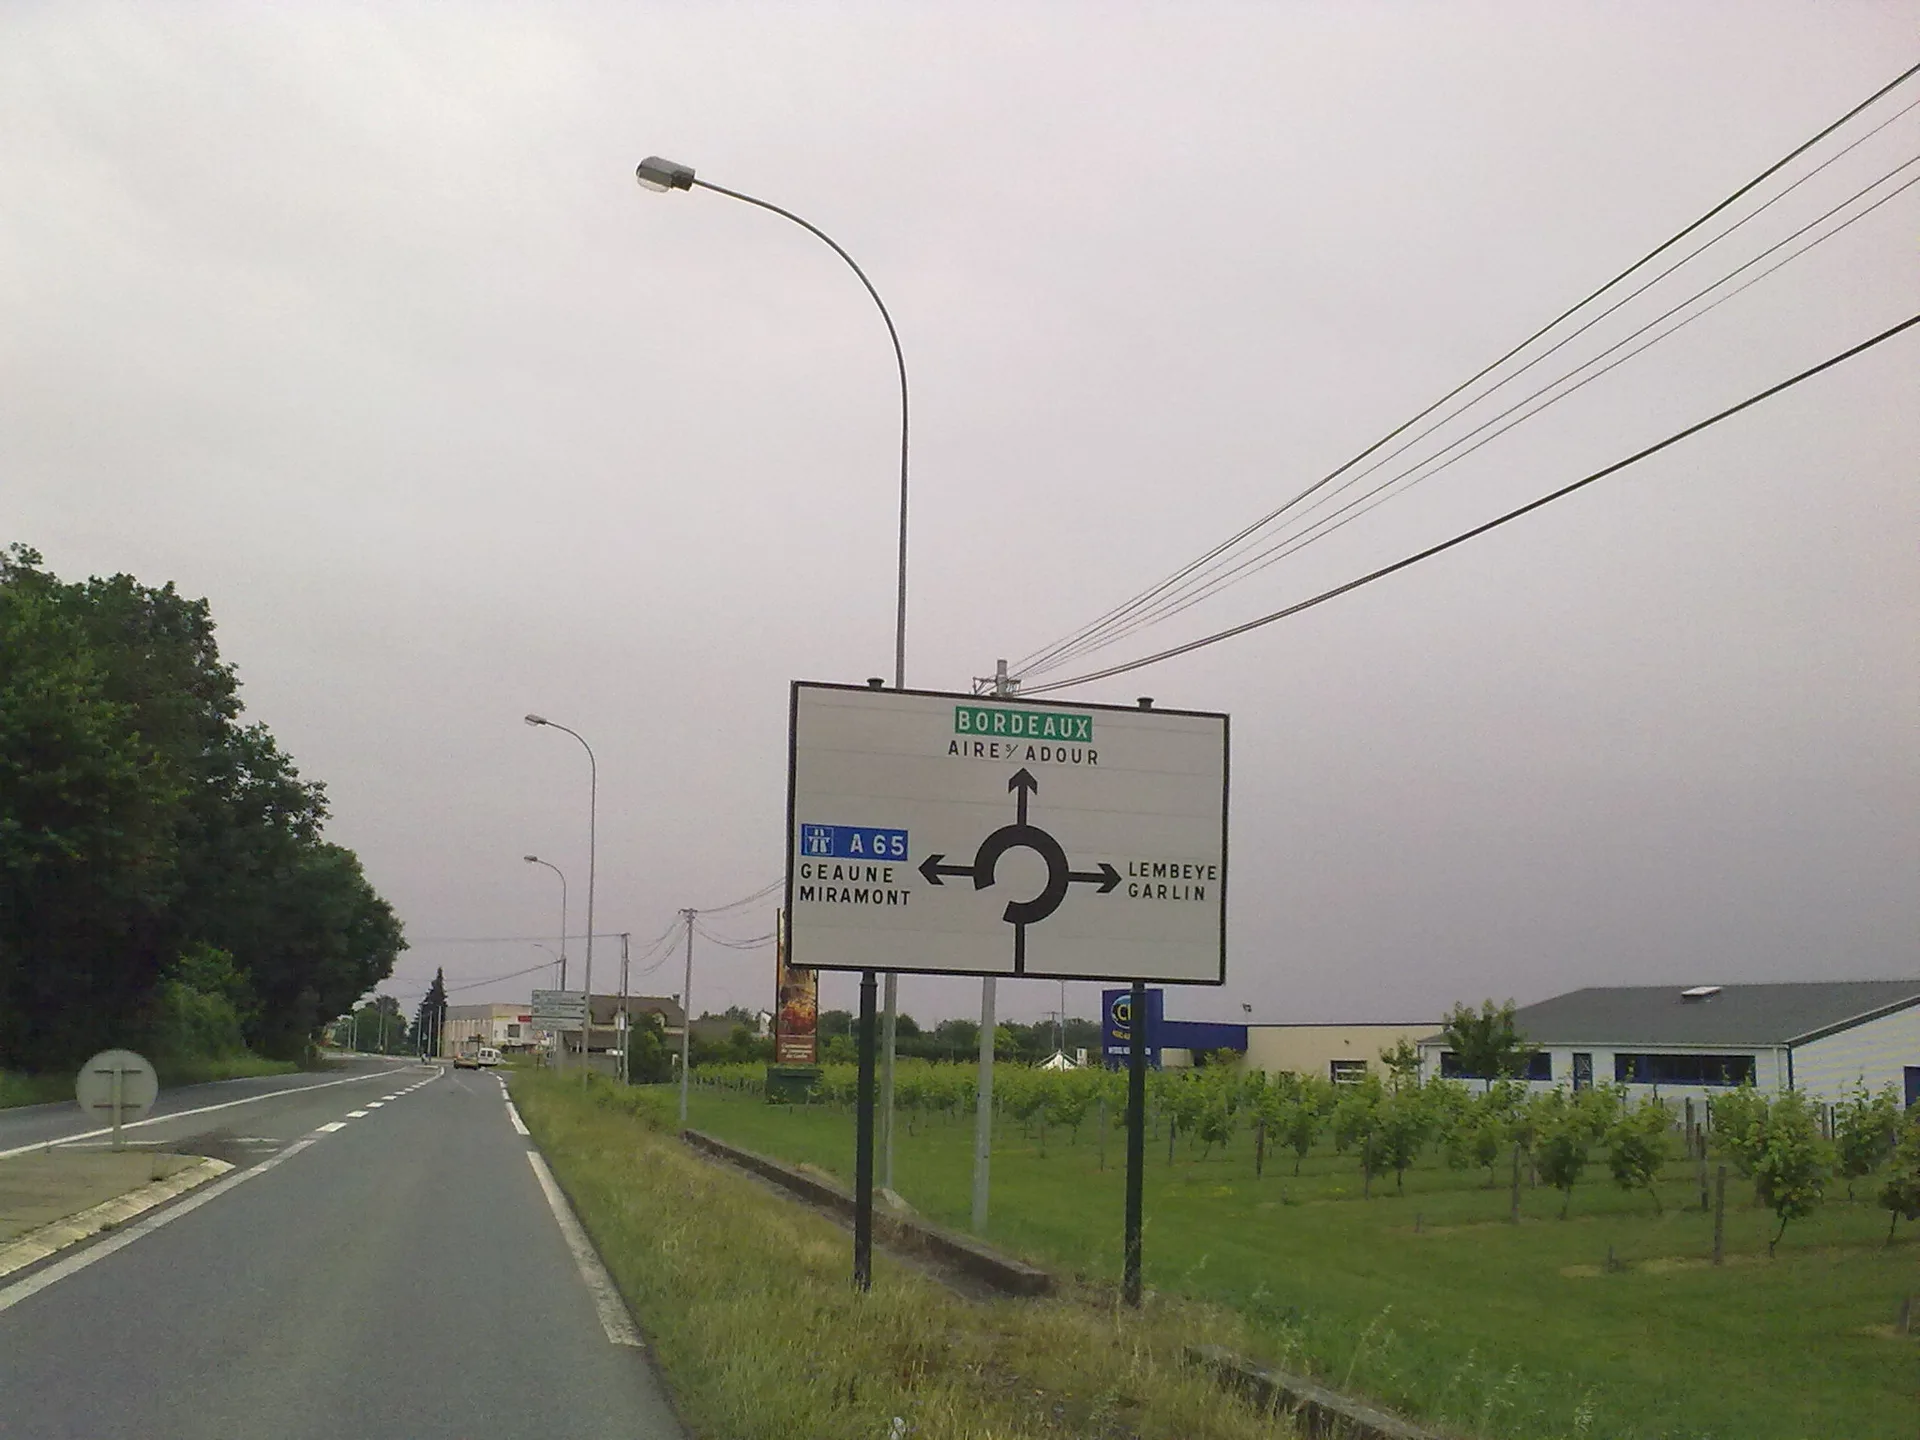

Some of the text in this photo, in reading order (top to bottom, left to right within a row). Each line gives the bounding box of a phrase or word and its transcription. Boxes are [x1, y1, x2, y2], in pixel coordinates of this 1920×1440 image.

[958, 710, 1088, 739] BORDEAUX
[948, 740, 999, 758] AIRE
[1025, 745, 1098, 765] ADOUR
[801, 863, 893, 883] GEAUNE
[1129, 861, 1217, 880] LEMBEYE
[800, 886, 911, 905] MIRAMONT
[1128, 883, 1204, 901] GARLIN
